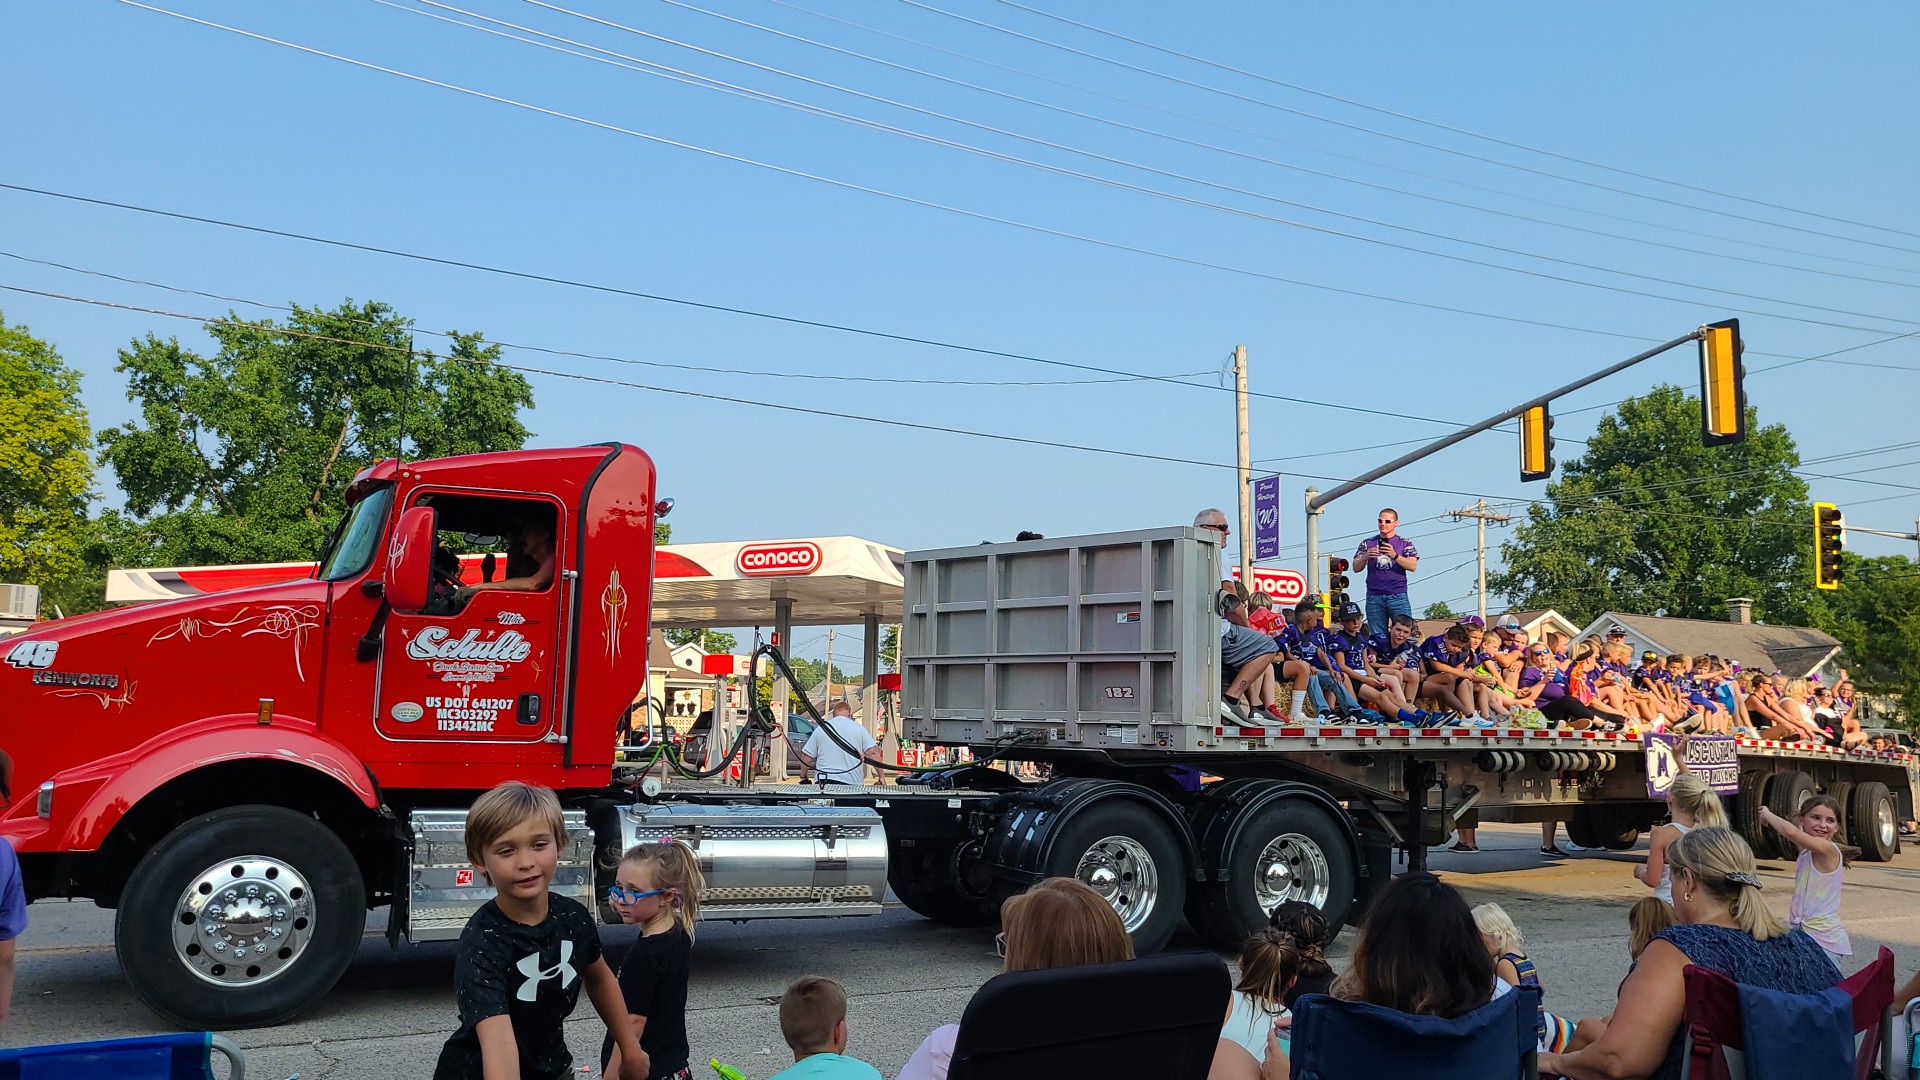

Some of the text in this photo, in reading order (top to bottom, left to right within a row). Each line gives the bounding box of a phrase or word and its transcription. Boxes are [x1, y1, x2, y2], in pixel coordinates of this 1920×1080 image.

[1259, 509, 1273, 524] M
[498, 611, 525, 625] Mike
[406, 626, 531, 662] Schulte
[4, 641, 59, 669] 46
[433, 661, 459, 672] Truck
[459, 662, 485, 673] Service
[32, 670, 119, 688] KENWORTH
[1105, 687, 1134, 698] 182
[425, 697, 514, 709] US DOT 641207
[436, 709, 498, 720] MC303292
[437, 720, 494, 732] 113442MC
[1657, 751, 1670, 778] M
